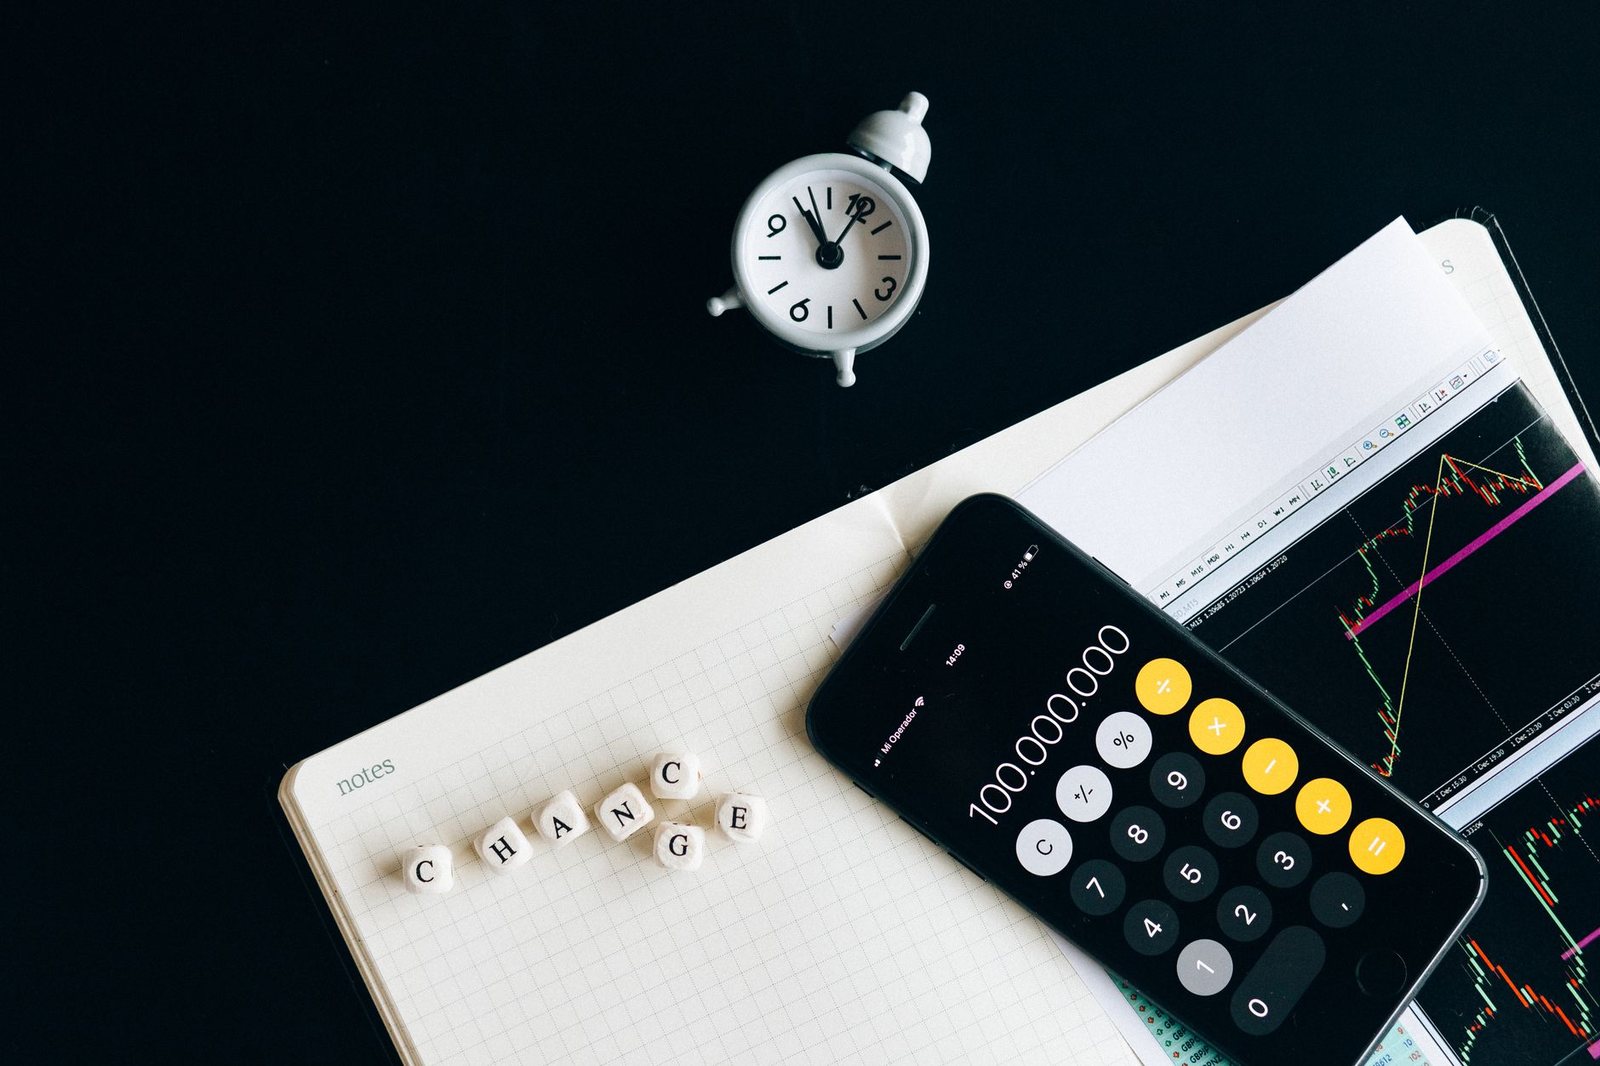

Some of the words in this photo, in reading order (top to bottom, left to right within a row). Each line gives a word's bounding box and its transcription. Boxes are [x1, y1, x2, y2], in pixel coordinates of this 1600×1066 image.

[767, 214, 787, 238] 9
[874, 276, 898, 301] 3
[789, 298, 811, 322] 6
[1160, 590, 1170, 601] M1
[1175, 578, 1186, 588] M5
[1190, 565, 1204, 577] M15
[1257, 519, 1268, 529] D1
[1273, 507, 1285, 517] W1
[1012, 568, 1021, 580] 41
[945, 643, 966, 667] 14:09
[881, 741, 892, 754] Mi
[889, 707, 918, 744] Operador
[969, 624, 1130, 825] 100.000.000
[1113, 731, 1135, 750] %
[336, 756, 396, 796] notes
[661, 762, 682, 784] C
[1167, 771, 1188, 790] 9
[611, 801, 635, 826] N
[731, 806, 748, 830] E
[1221, 810, 1241, 830] 6
[553, 815, 572, 838] A
[1127, 824, 1149, 844] 8
[489, 837, 517, 863] H
[668, 834, 689, 857] G
[1036, 839, 1053, 856] C
[1274, 850, 1295, 870] 3
[416, 861, 434, 883] C
[1180, 863, 1202, 884] 5
[1086, 876, 1105, 898] 7
[1234, 904, 1257, 925] 2
[1143, 917, 1163, 938] 4
[1196, 959, 1215, 974] 1
[1248, 998, 1269, 1018] 0
